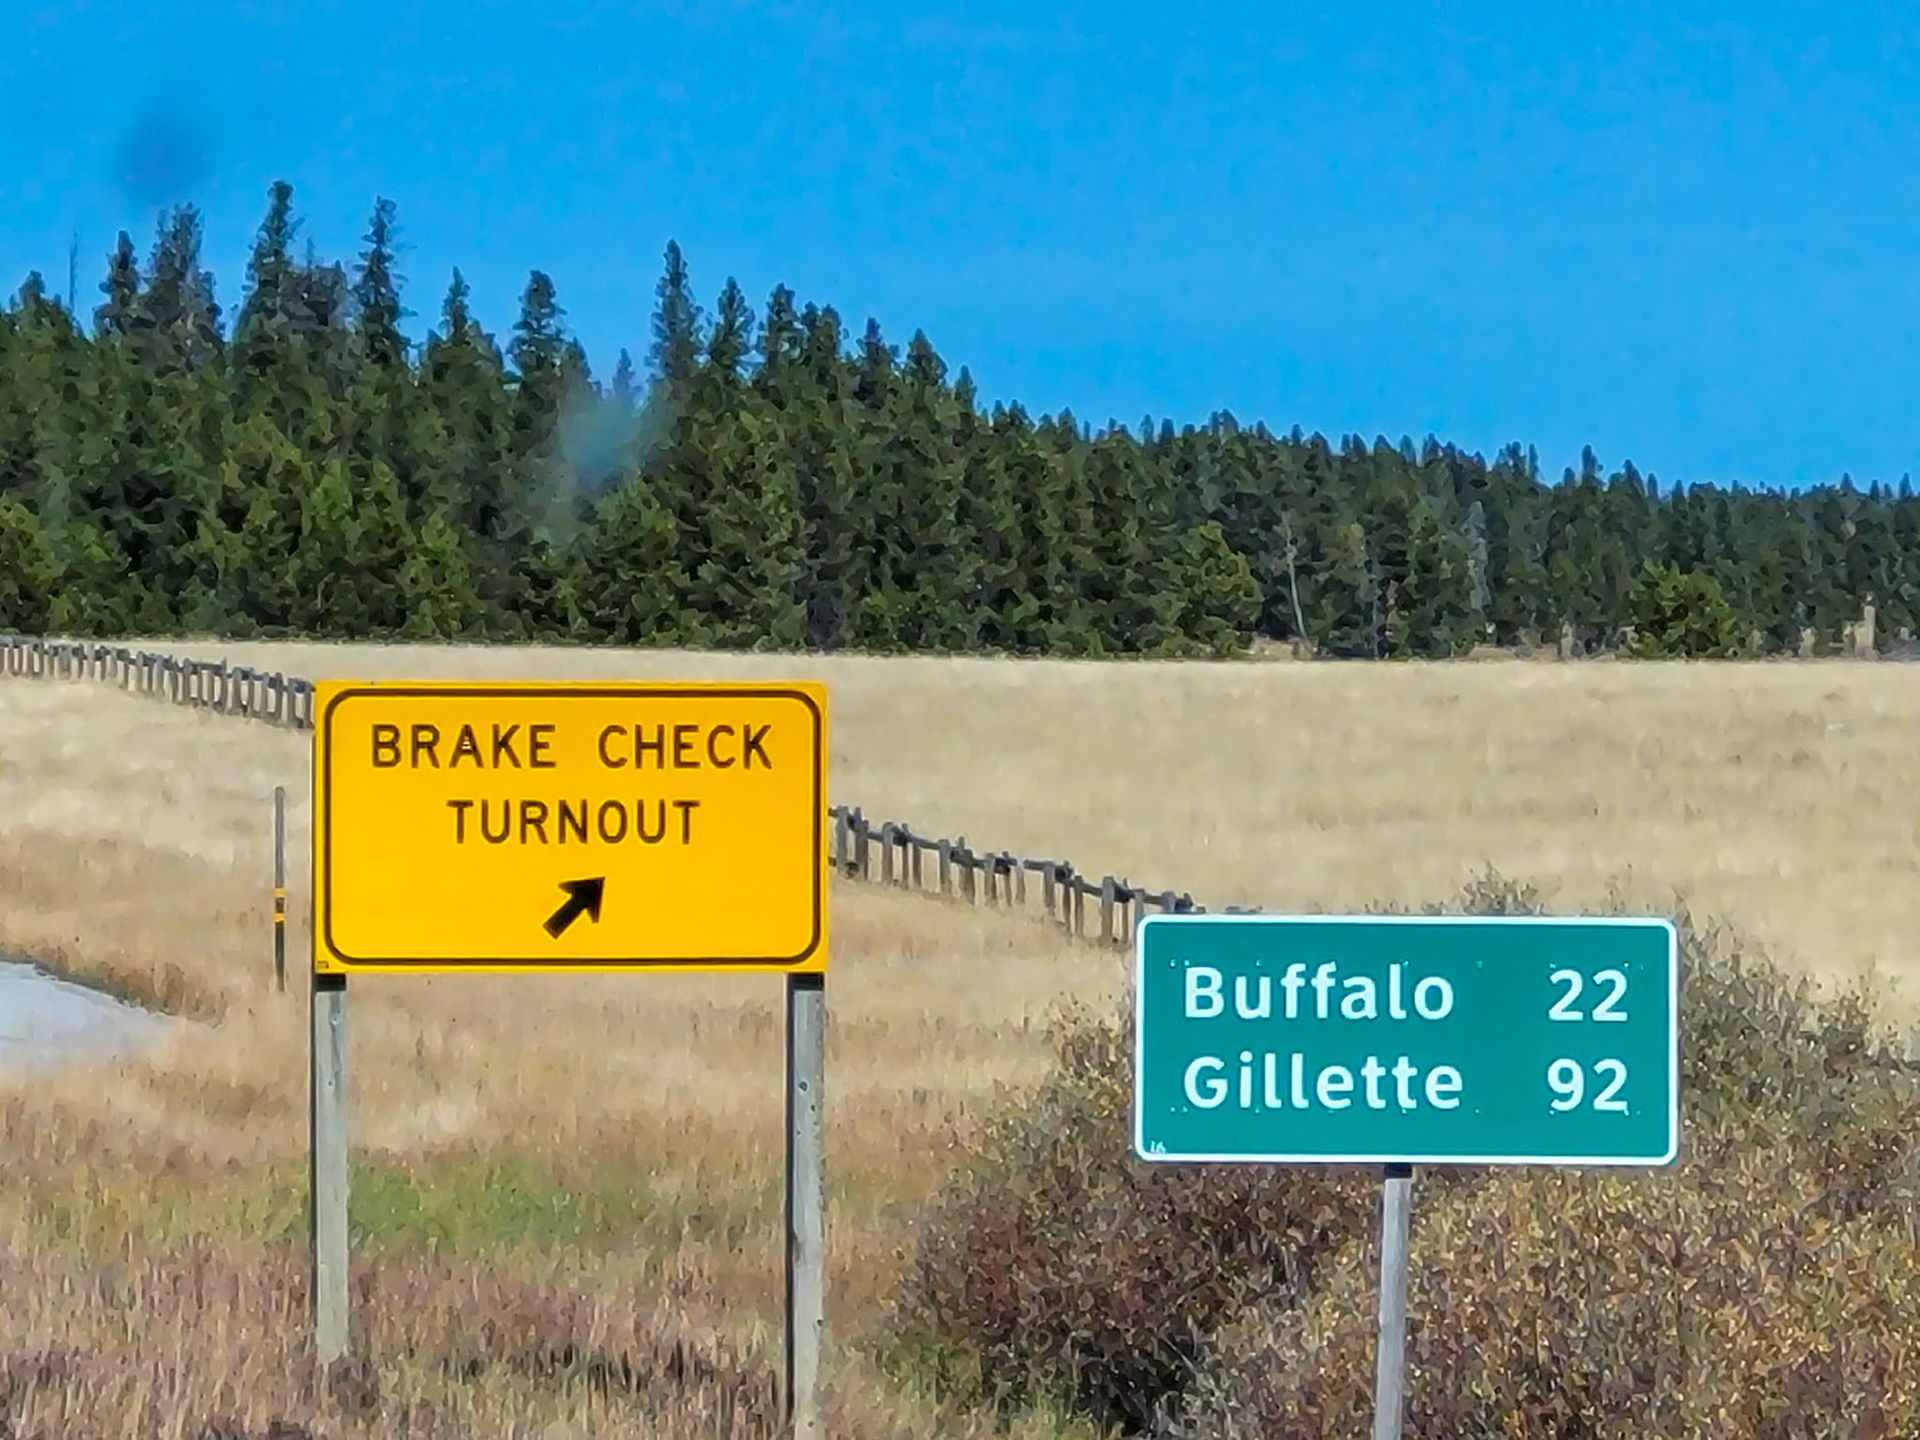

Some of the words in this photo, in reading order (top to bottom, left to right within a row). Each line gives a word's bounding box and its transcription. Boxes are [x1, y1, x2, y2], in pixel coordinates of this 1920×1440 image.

[372, 724, 556, 769] BRAKE
[598, 724, 772, 769] CHECK
[446, 799, 700, 845] TURNOUT
[1184, 961, 1454, 1020] Buffalo
[1548, 968, 1628, 1021] 22
[1183, 1050, 1464, 1109] Gillette
[1546, 1057, 1628, 1112] 92
